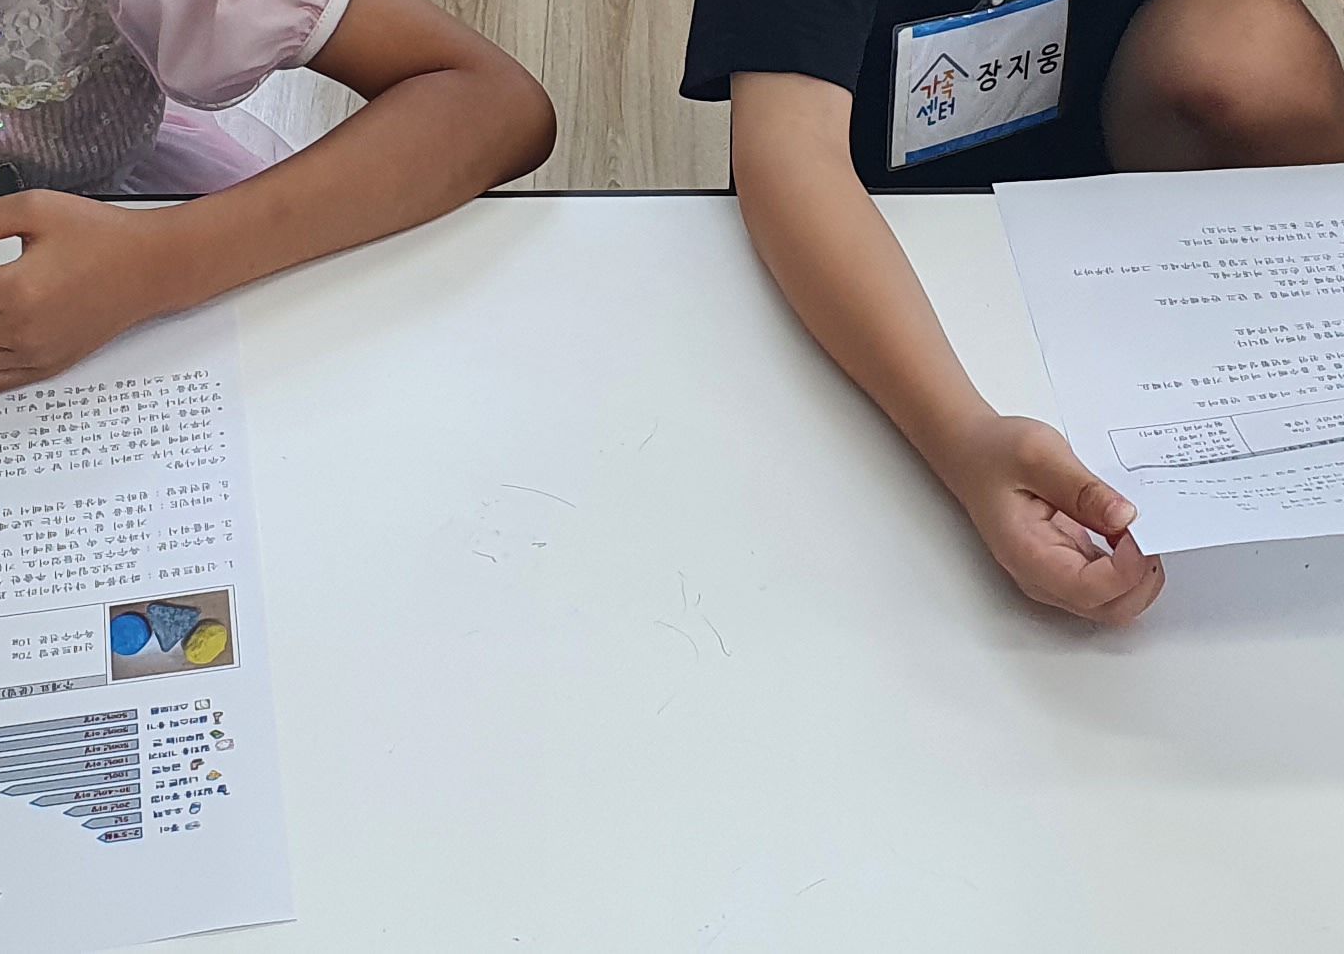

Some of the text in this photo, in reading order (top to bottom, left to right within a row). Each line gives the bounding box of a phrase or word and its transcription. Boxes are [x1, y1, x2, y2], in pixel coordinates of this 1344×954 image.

[976, 44, 1062, 93] 장지웅
[919, 69, 955, 99] 가족
[916, 96, 956, 126] 센터
